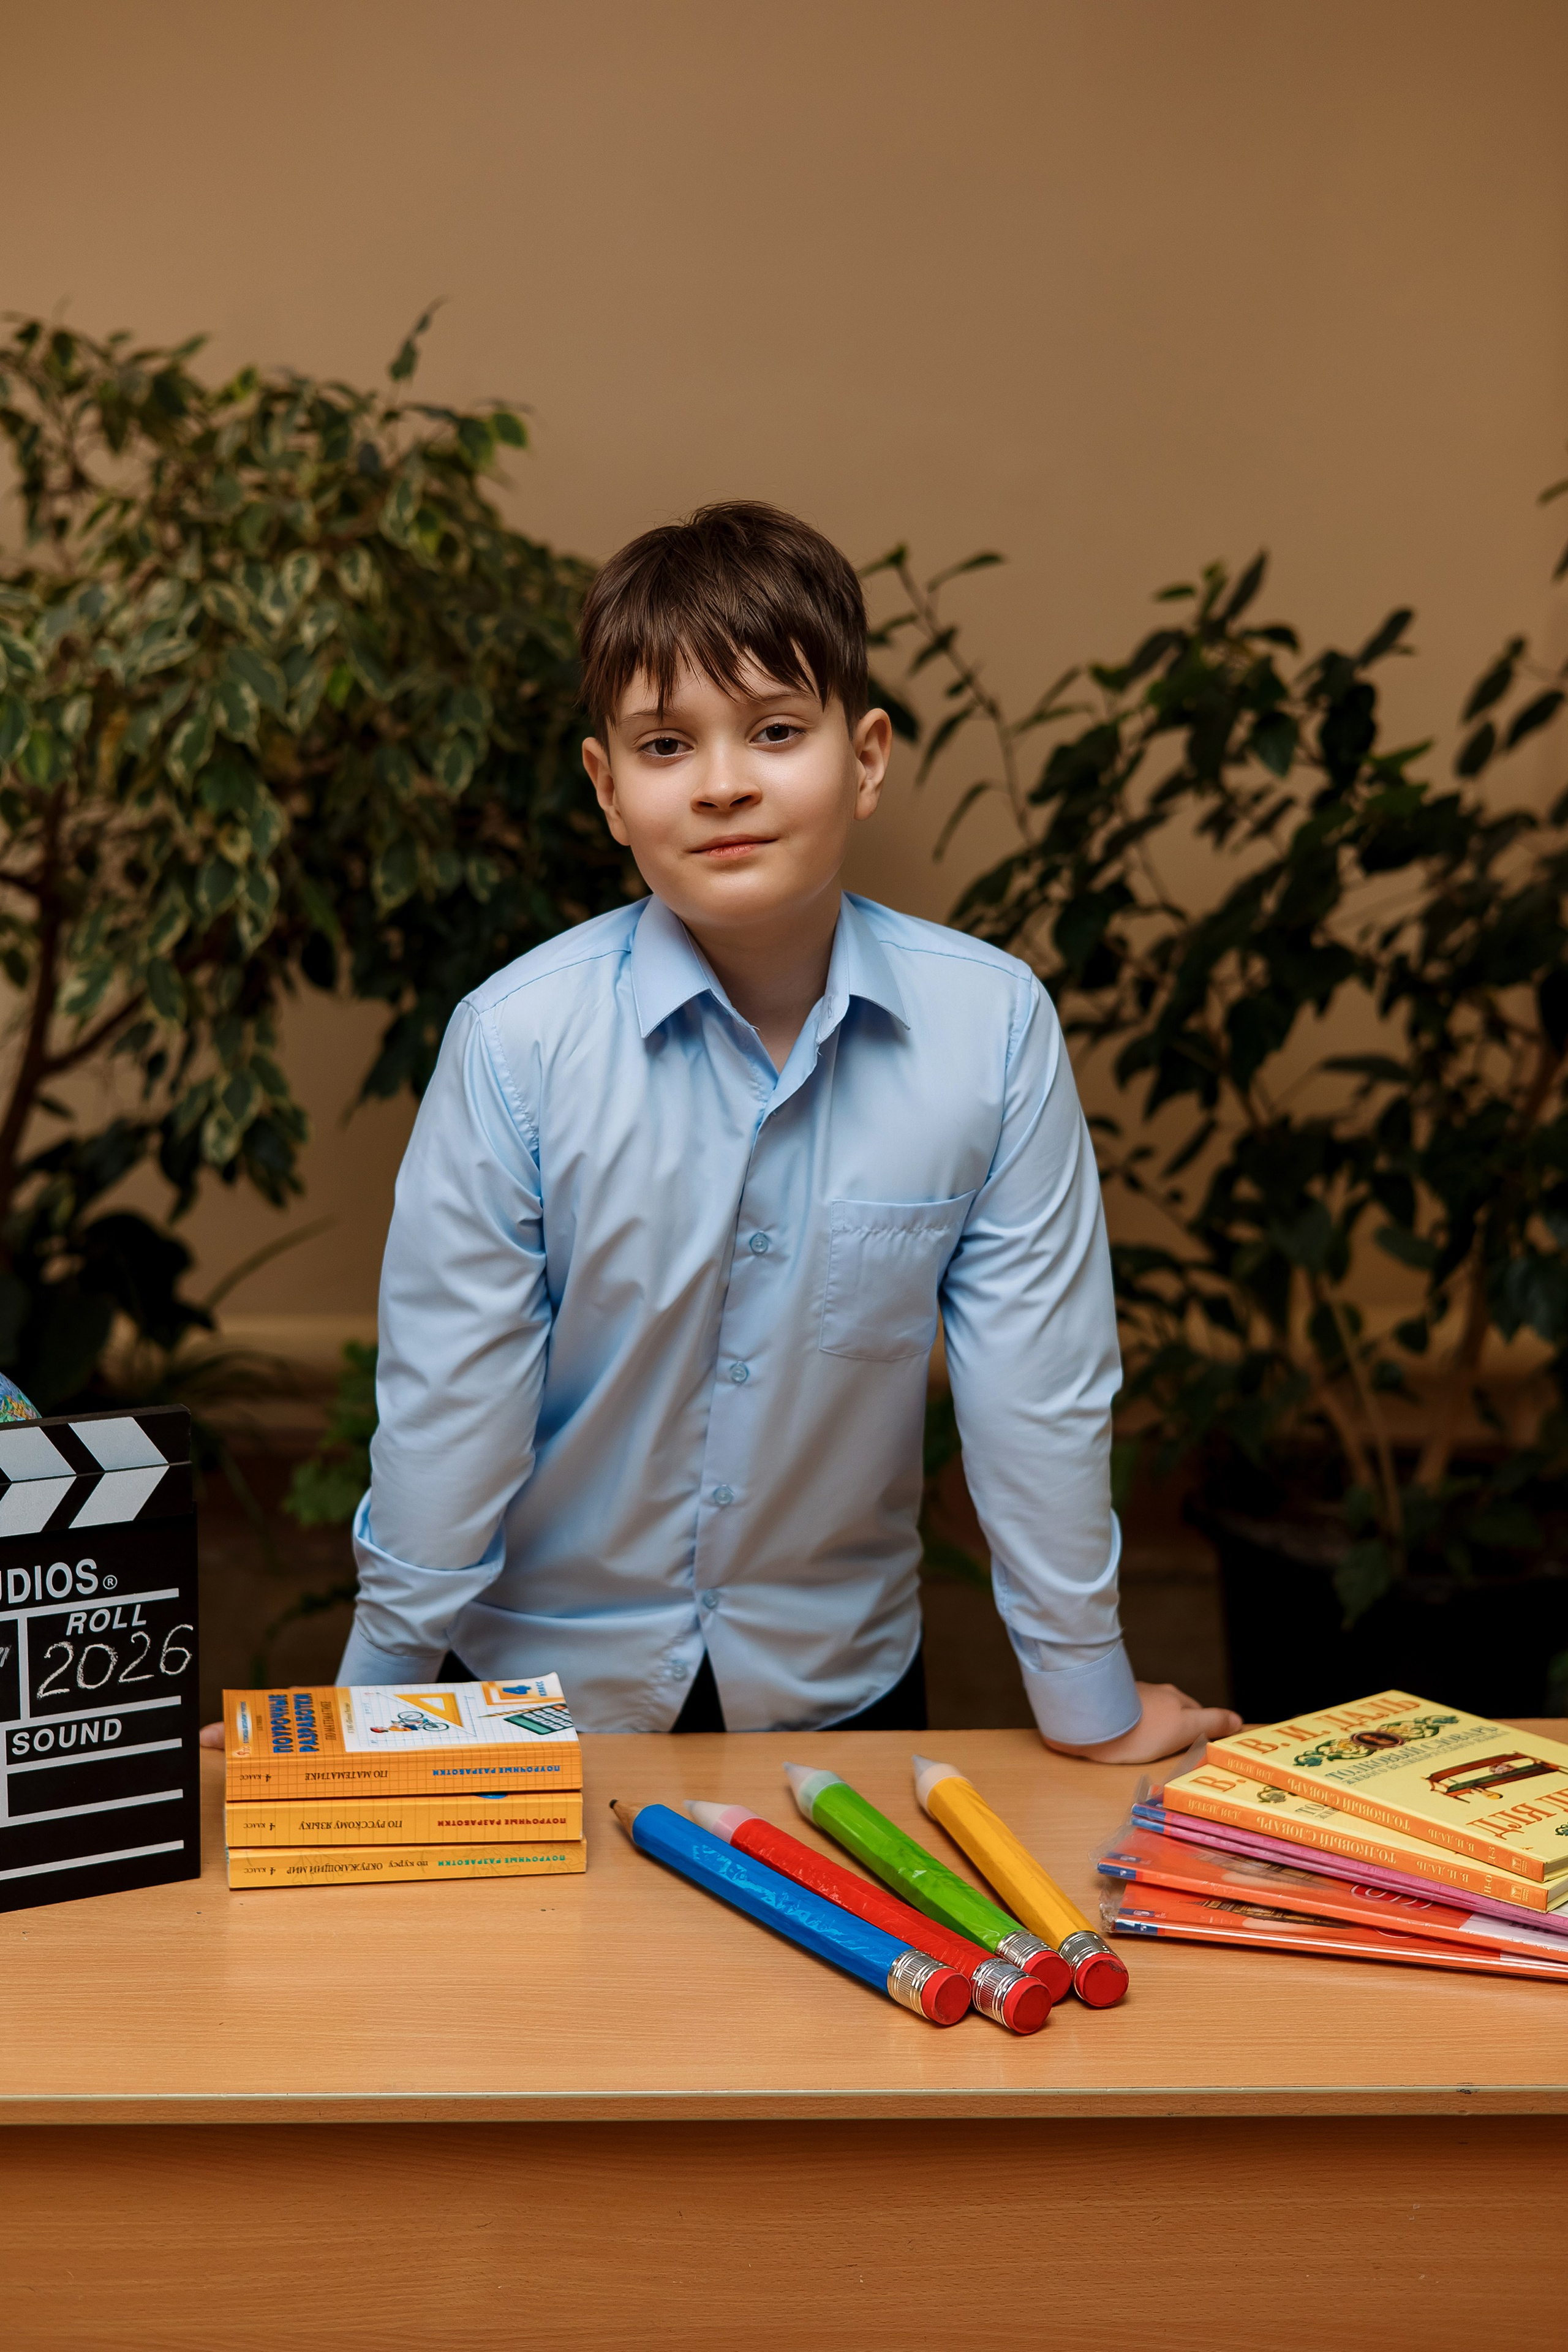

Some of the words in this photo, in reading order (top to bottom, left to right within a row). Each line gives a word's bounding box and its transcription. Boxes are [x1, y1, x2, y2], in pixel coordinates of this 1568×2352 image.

[66, 1604, 147, 1635] ROLL
[36, 1624, 194, 1699] 2026
[502, 1685, 531, 1695] 4
[268, 1694, 293, 1753] ПОУРОЧНЫЕ
[293, 1693, 319, 1752] РАЗРАБОТКИ
[1233, 1737, 1290, 1754] В.
[1269, 1725, 1331, 1742] И.
[1314, 1697, 1420, 1731] ДАЛЬ
[11, 1718, 122, 1755] SOUND
[1325, 1745, 1421, 1781] ТОЛКОВЫЙ
[1420, 1725, 1499, 1752] СЛОВАРЬ
[304, 1771, 372, 1781] МАТЕМАТИКЕ
[499, 1765, 560, 1774] ПОУРОЧНЫЕ
[265, 1774, 271, 1782] 4
[1189, 1776, 1246, 1792] В.
[1287, 1777, 1340, 1806] СЛОВАРЬ
[1342, 1797, 1411, 1831] ТОЛКОВЫЙ
[1465, 1803, 1557, 1840] ДЛЯ
[298, 1822, 332, 1830] ЯЗЫКУ
[333, 1819, 386, 1830] РУССКОМУ
[1257, 1815, 1316, 1842] СЛОВАРЬ
[1428, 1828, 1453, 1844] ДАЛЬ
[1320, 1833, 1396, 1864] ТОЛКОВЫЙ
[285, 1866, 307, 1874] МИР
[309, 1862, 383, 1874] ОКРУЖАЮЩИЙ
[388, 1860, 415, 1868] курсу
[438, 1858, 501, 1866] РАЗРАБОТКИ
[1416, 1860, 1446, 1875] ДАЛЬ
[270, 1867, 276, 1875] 4
[1460, 1873, 1469, 1883] В.
